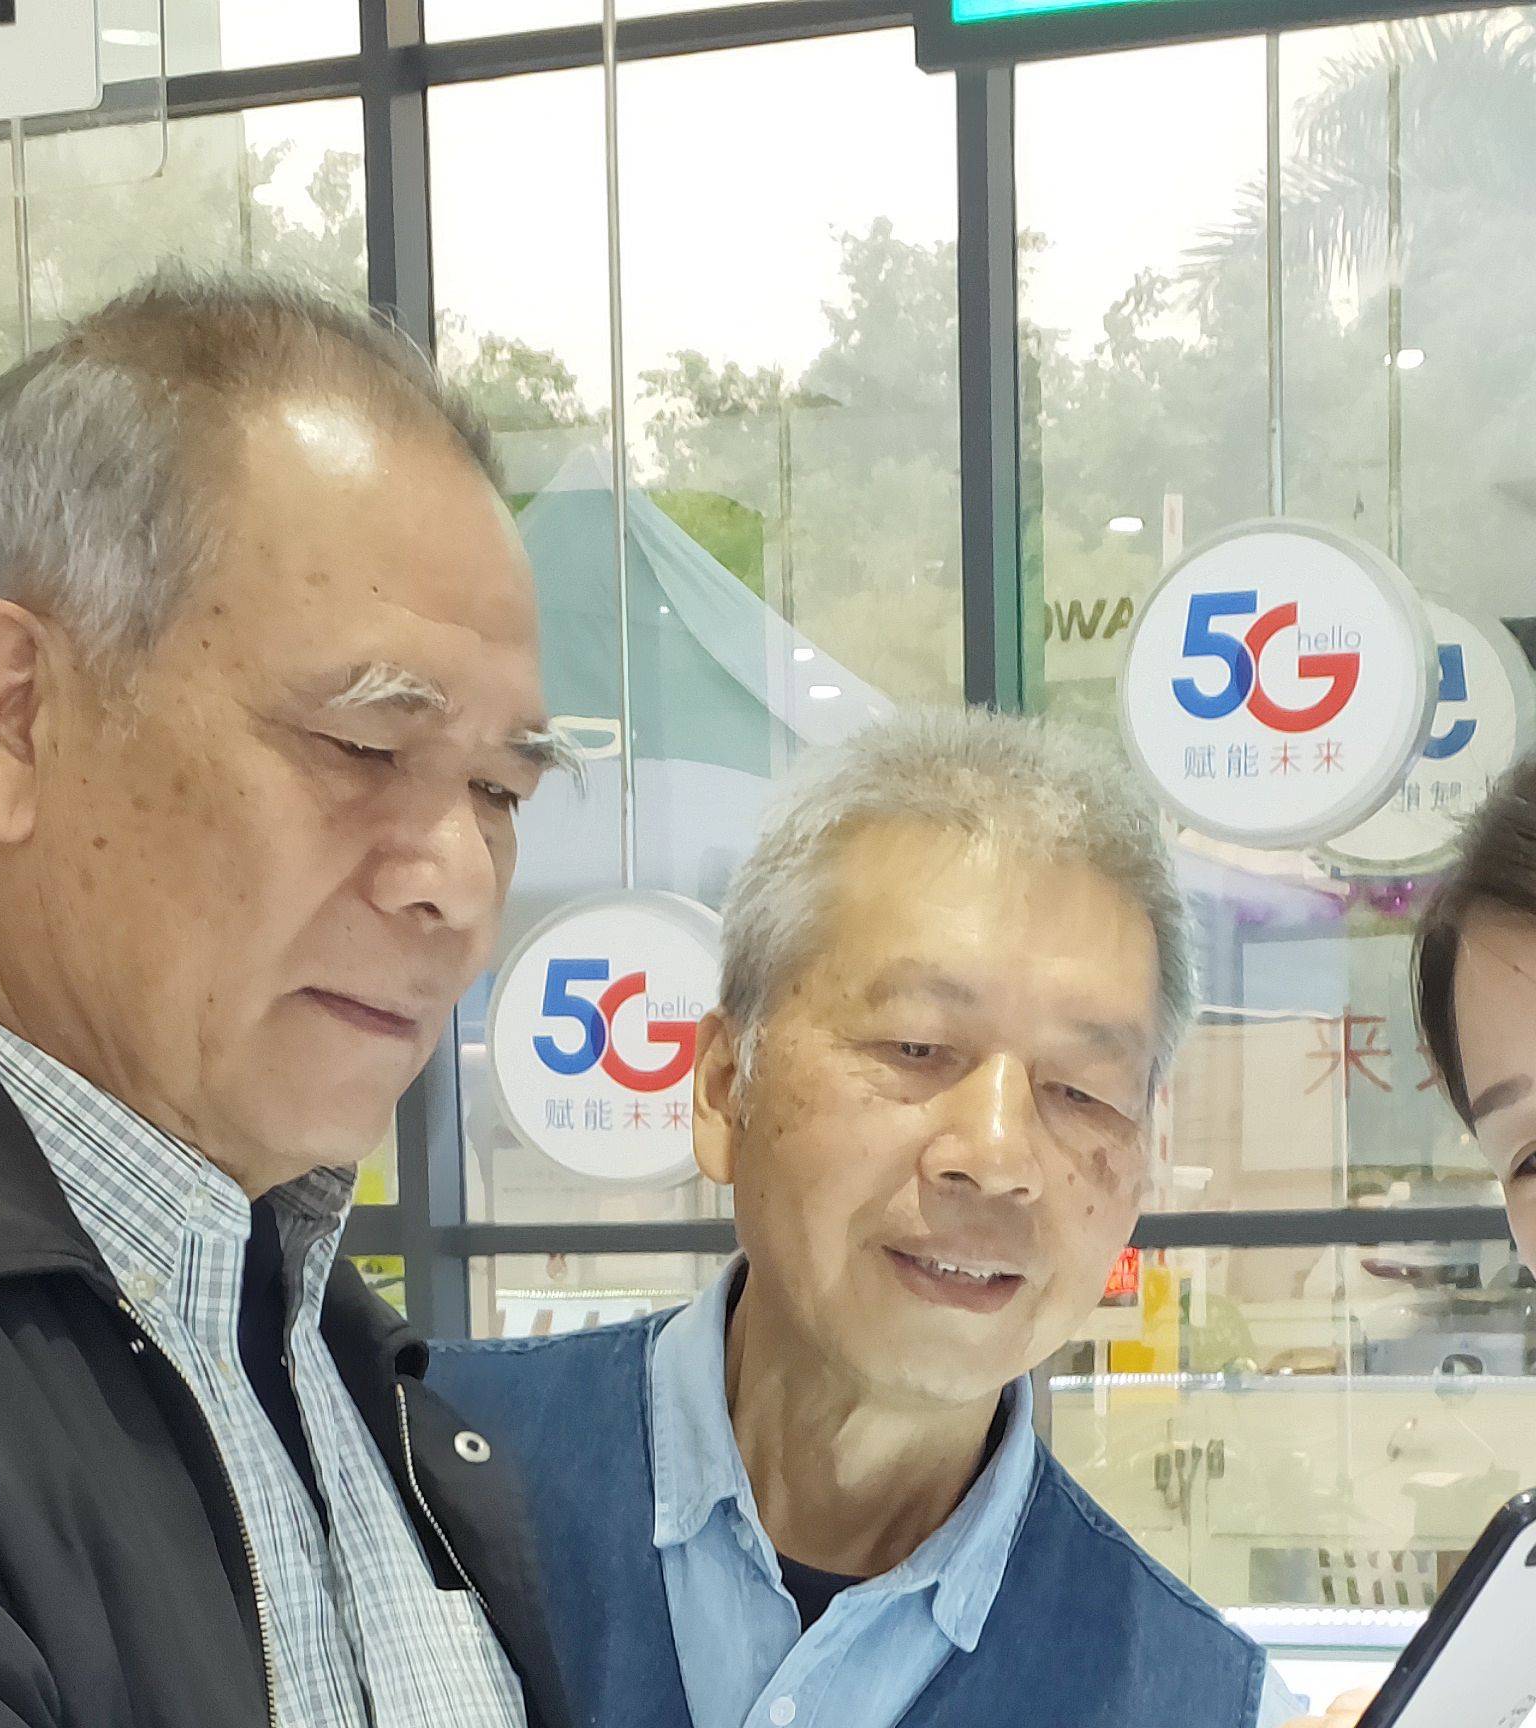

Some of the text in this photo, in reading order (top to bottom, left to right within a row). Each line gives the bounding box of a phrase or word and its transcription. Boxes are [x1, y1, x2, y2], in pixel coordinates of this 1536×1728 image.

[1297, 624, 1362, 652] hello
[1170, 589, 1361, 734] 5G
[1183, 738, 1345, 780] 赋能未来
[531, 958, 699, 1093] 5G
[645, 995, 705, 1019] hello
[544, 1097, 691, 1131] 赋能未来
